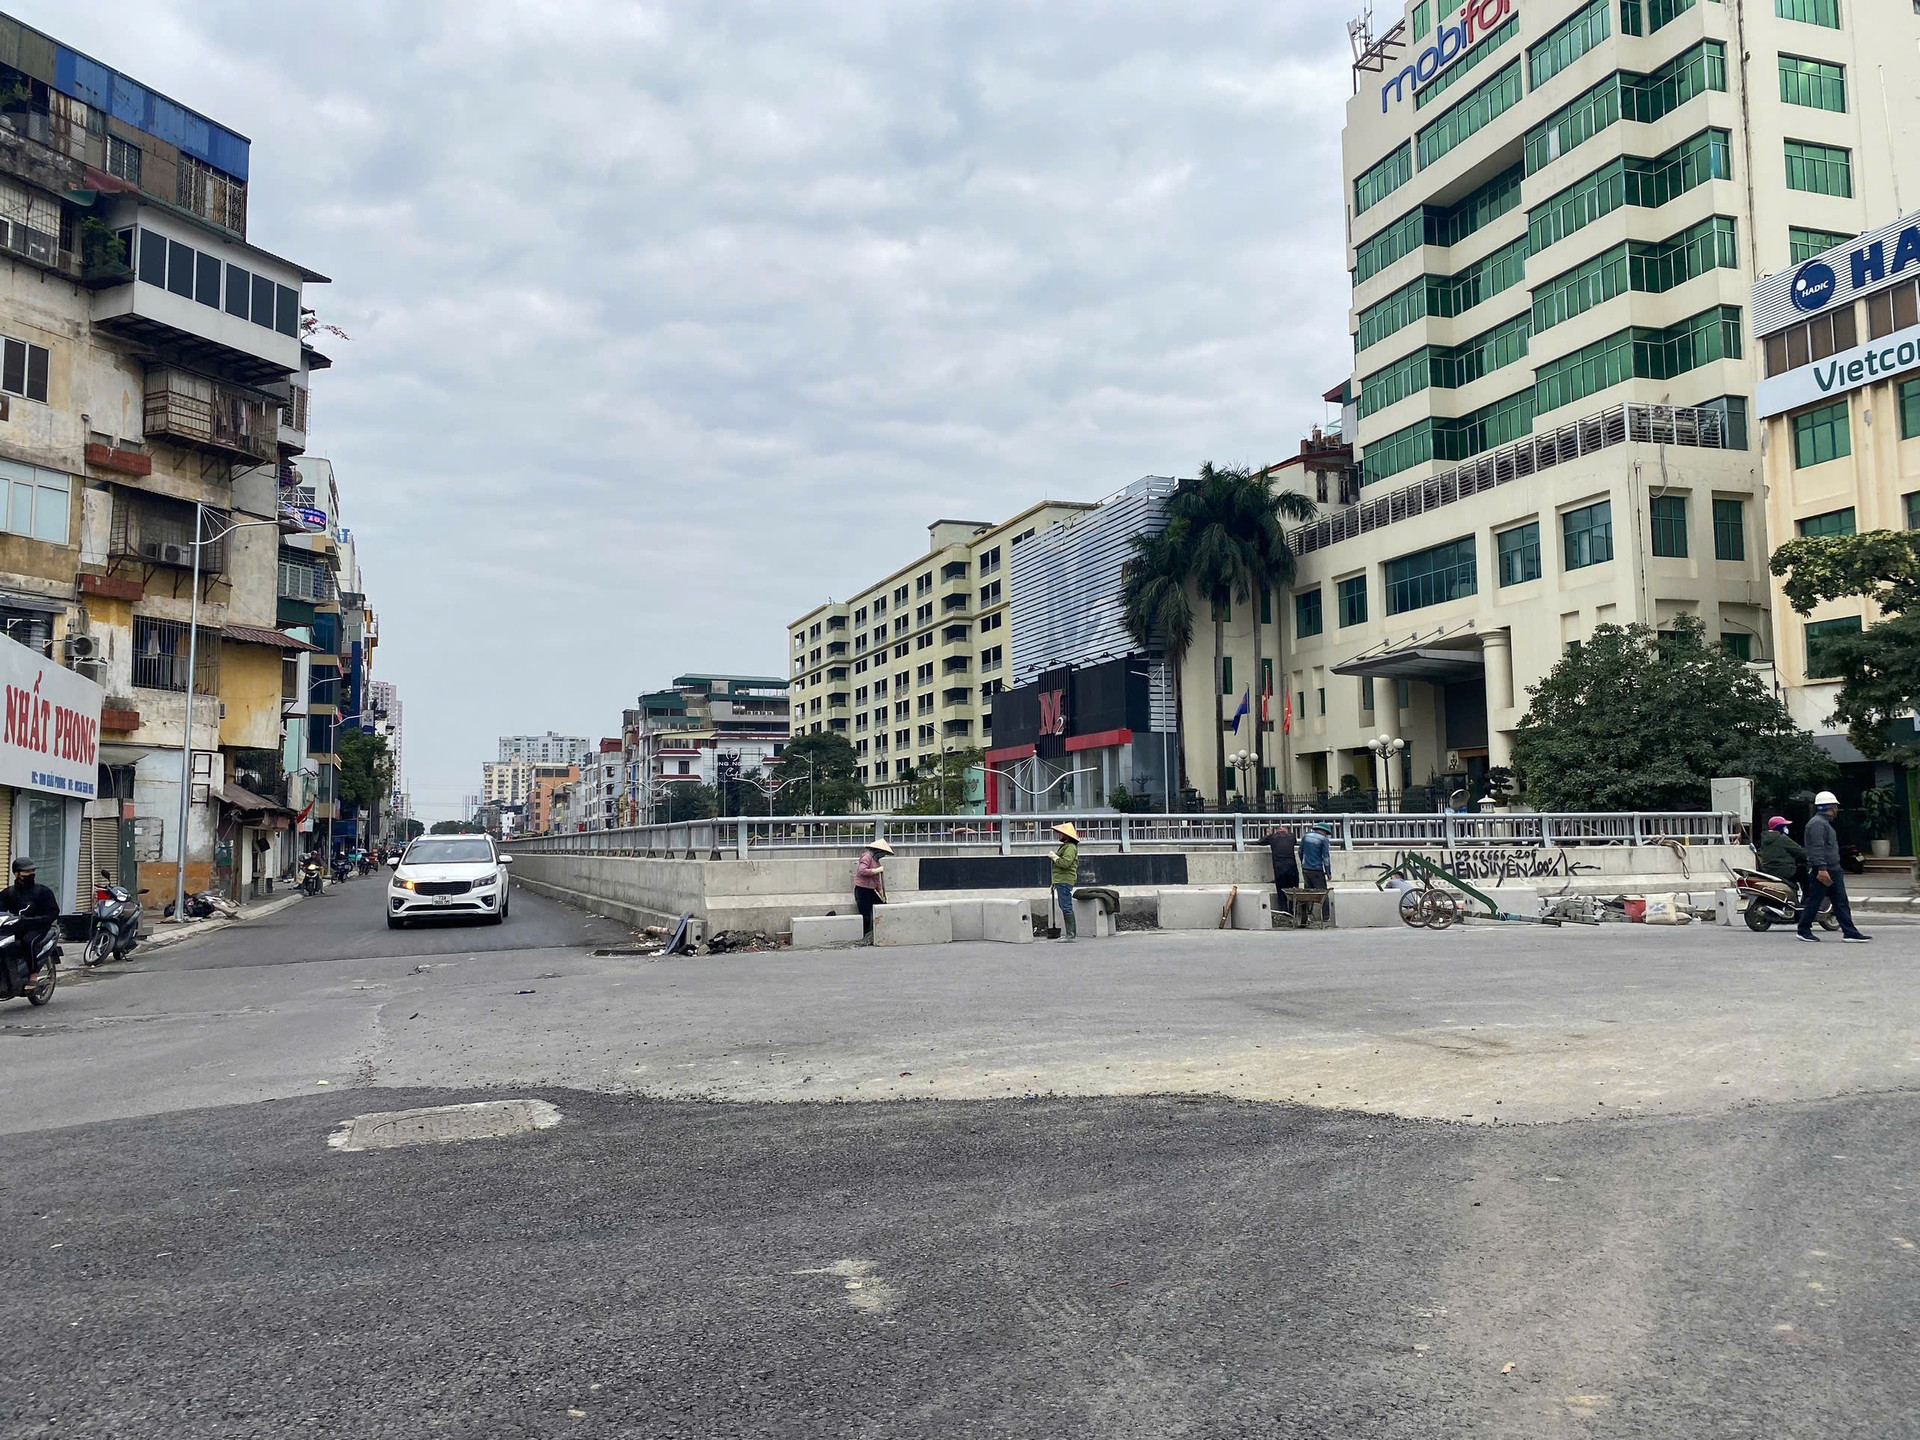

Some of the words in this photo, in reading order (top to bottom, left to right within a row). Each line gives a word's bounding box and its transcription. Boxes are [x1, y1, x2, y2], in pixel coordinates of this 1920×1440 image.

[1382, 0, 1510, 113] mobifo
[1802, 280, 1829, 298] HADIC
[1813, 338, 1920, 392] Vietco
[4, 670, 50, 754] NHẤT
[53, 705, 97, 766] PHONG
